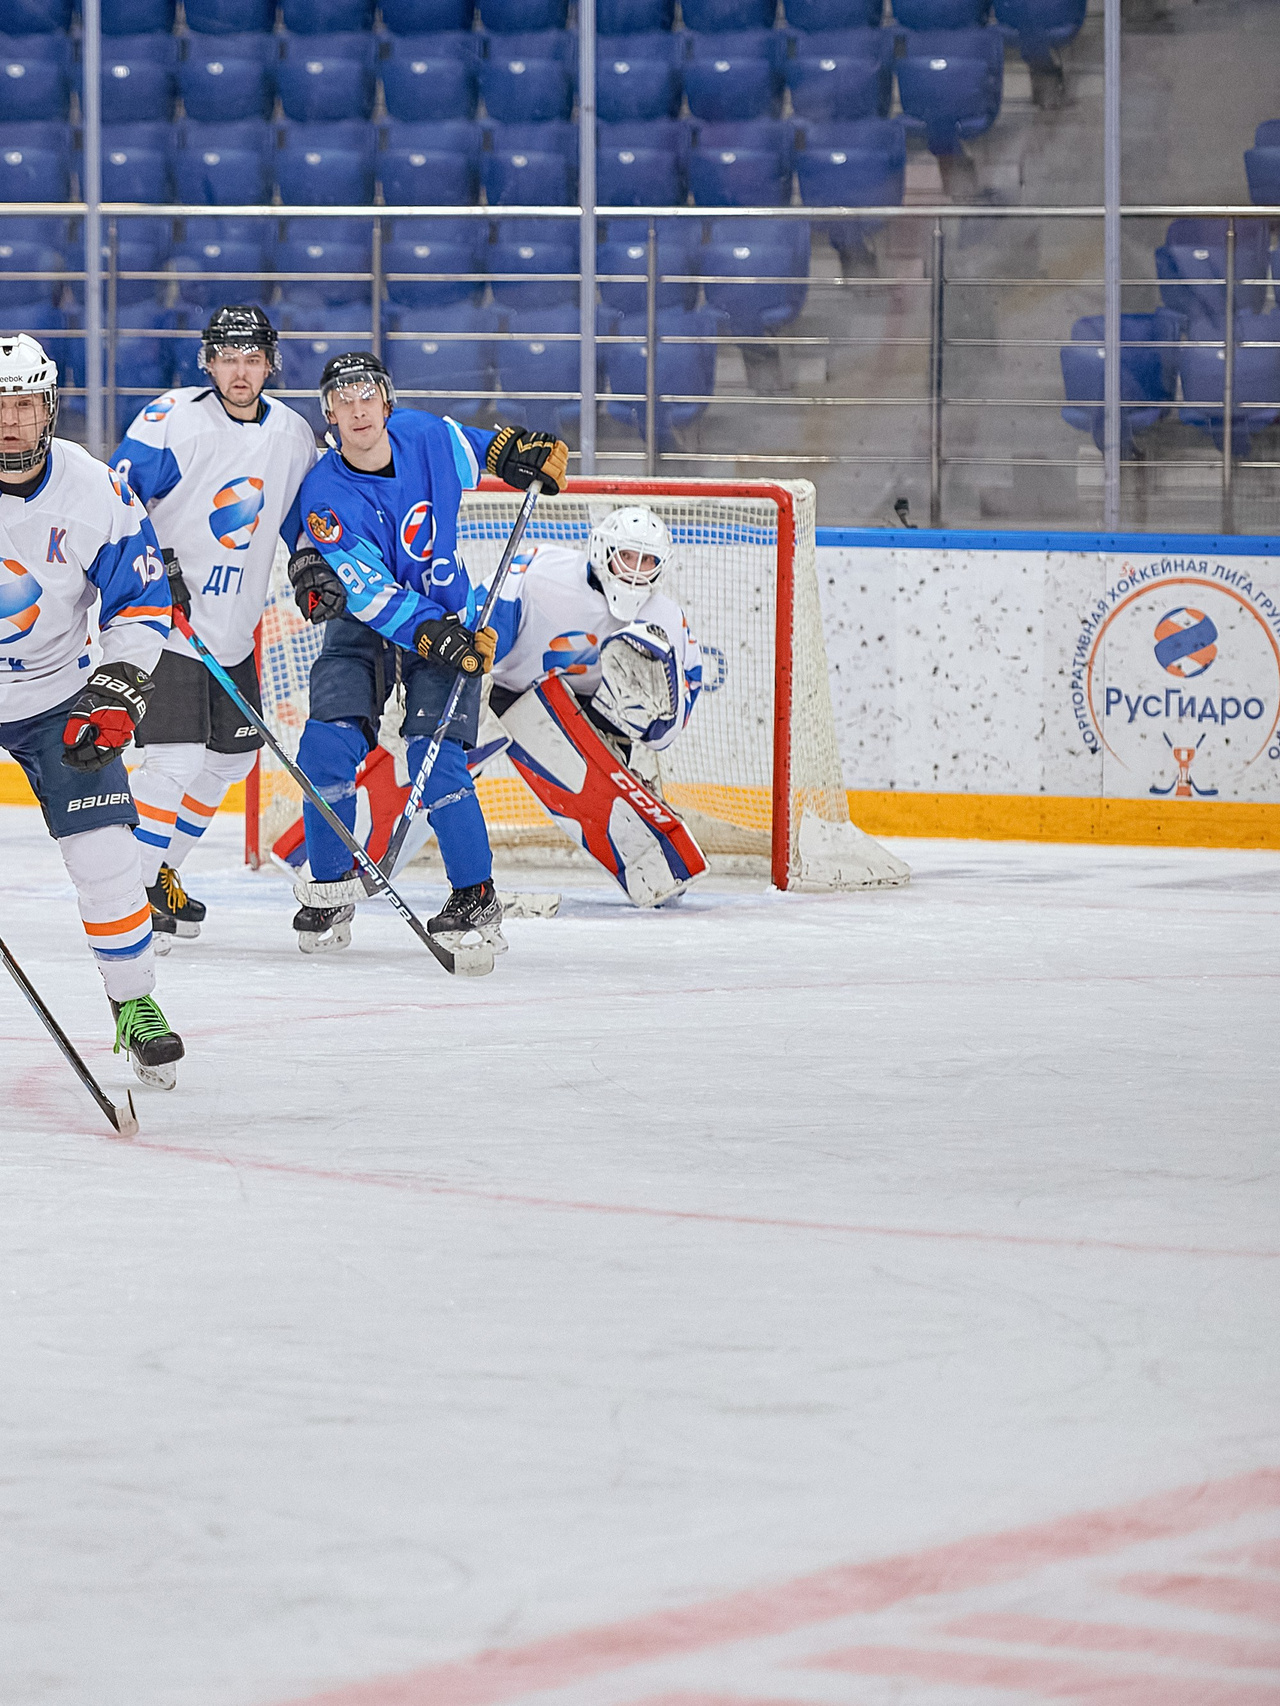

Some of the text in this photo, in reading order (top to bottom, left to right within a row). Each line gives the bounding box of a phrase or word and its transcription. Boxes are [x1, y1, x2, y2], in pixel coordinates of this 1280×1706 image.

[202, 565, 244, 596] ДГ
[1071, 599, 1110, 754] КОРПОРАТИВНАЯ
[1106, 557, 1209, 602] ХОККЕЙНАЯ
[1212, 564, 1253, 595] ЛИГА
[90, 673, 147, 723] BAUE
[1105, 687, 1265, 726] РусГидро
[67, 792, 130, 812] BAUER
[610, 769, 671, 823] CCM
